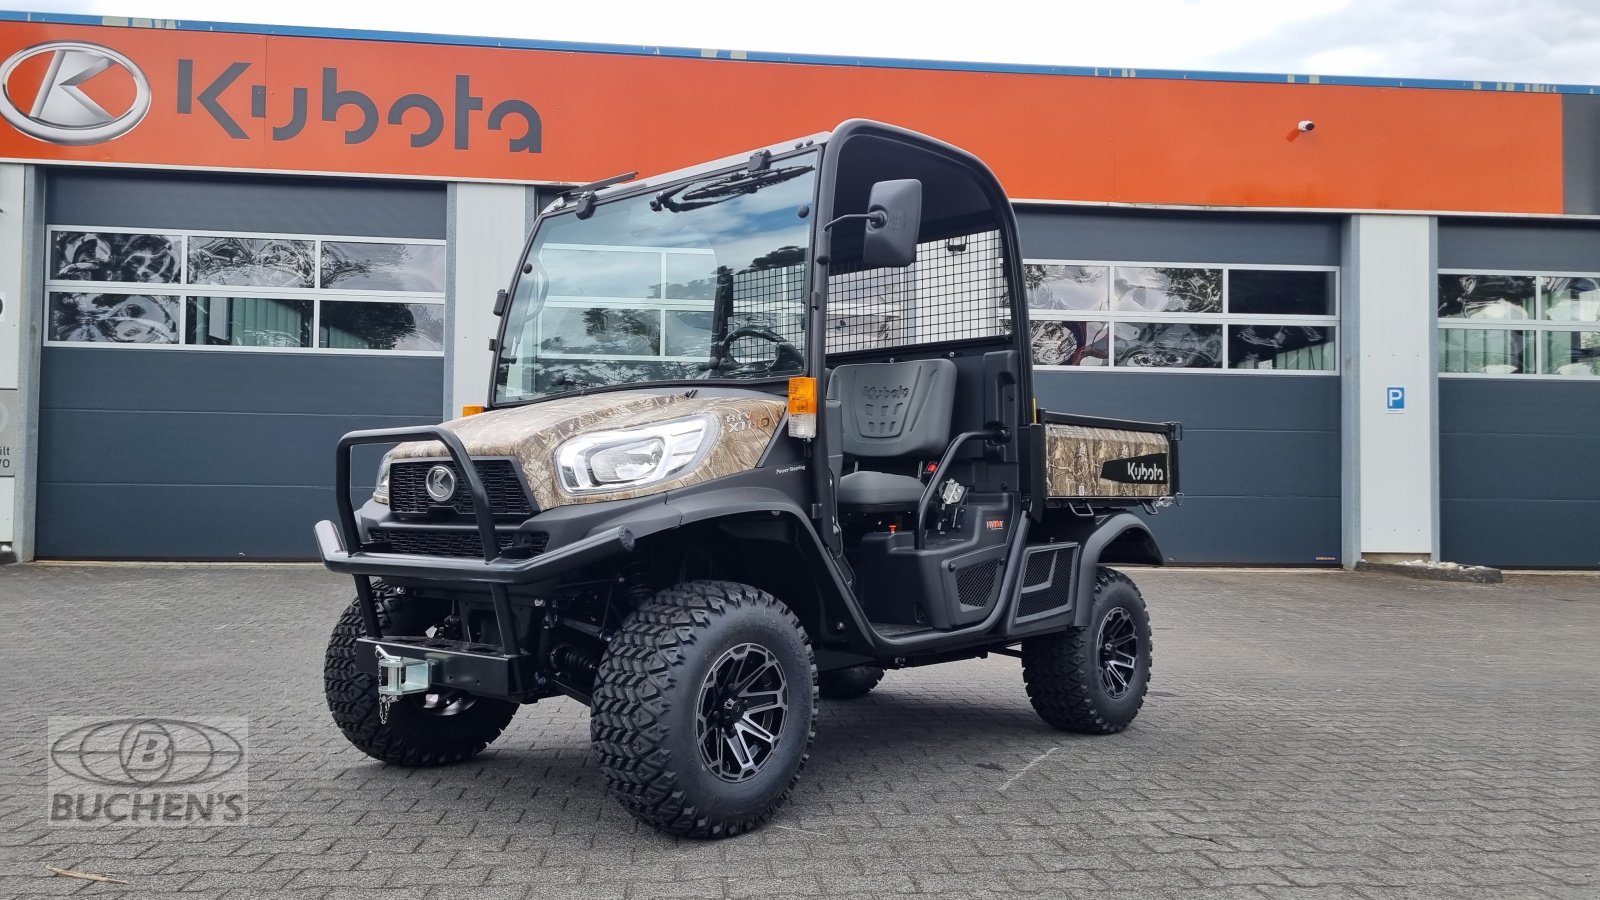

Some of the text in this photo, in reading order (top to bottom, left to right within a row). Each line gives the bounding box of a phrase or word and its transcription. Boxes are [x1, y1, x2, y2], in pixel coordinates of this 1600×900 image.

[176, 58, 542, 153] Kubota
[863, 384, 909, 399] Kubota
[1389, 389, 1403, 407] P
[1127, 462, 1164, 481] Kubota
